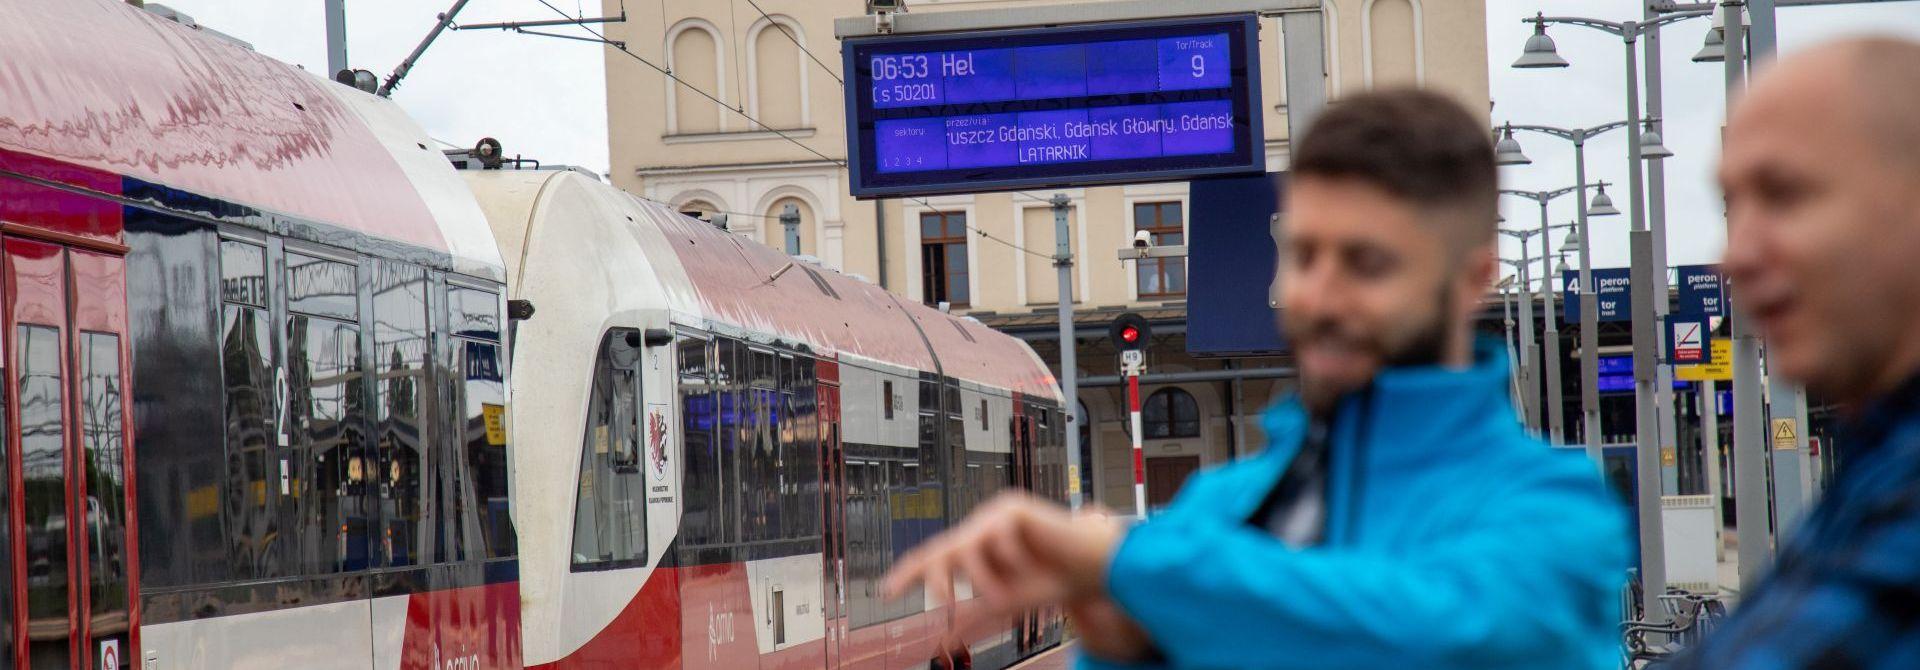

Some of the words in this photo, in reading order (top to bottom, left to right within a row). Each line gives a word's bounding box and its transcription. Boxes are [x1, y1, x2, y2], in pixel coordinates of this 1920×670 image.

[871, 55, 928, 81] 06:53
[942, 52, 975, 77] Hel
[1191, 54, 1205, 78] 9
[894, 83, 936, 102] 50201
[946, 129, 995, 145] uszcz
[1019, 143, 1088, 162] LATARNIK
[905, 156, 911, 166] 3
[916, 156, 922, 165] 4
[1567, 277, 1580, 295] 4
[1600, 277, 1630, 287] peron
[1687, 274, 1717, 286] peron
[1601, 300, 1616, 310] tor
[1703, 297, 1718, 306] tor
